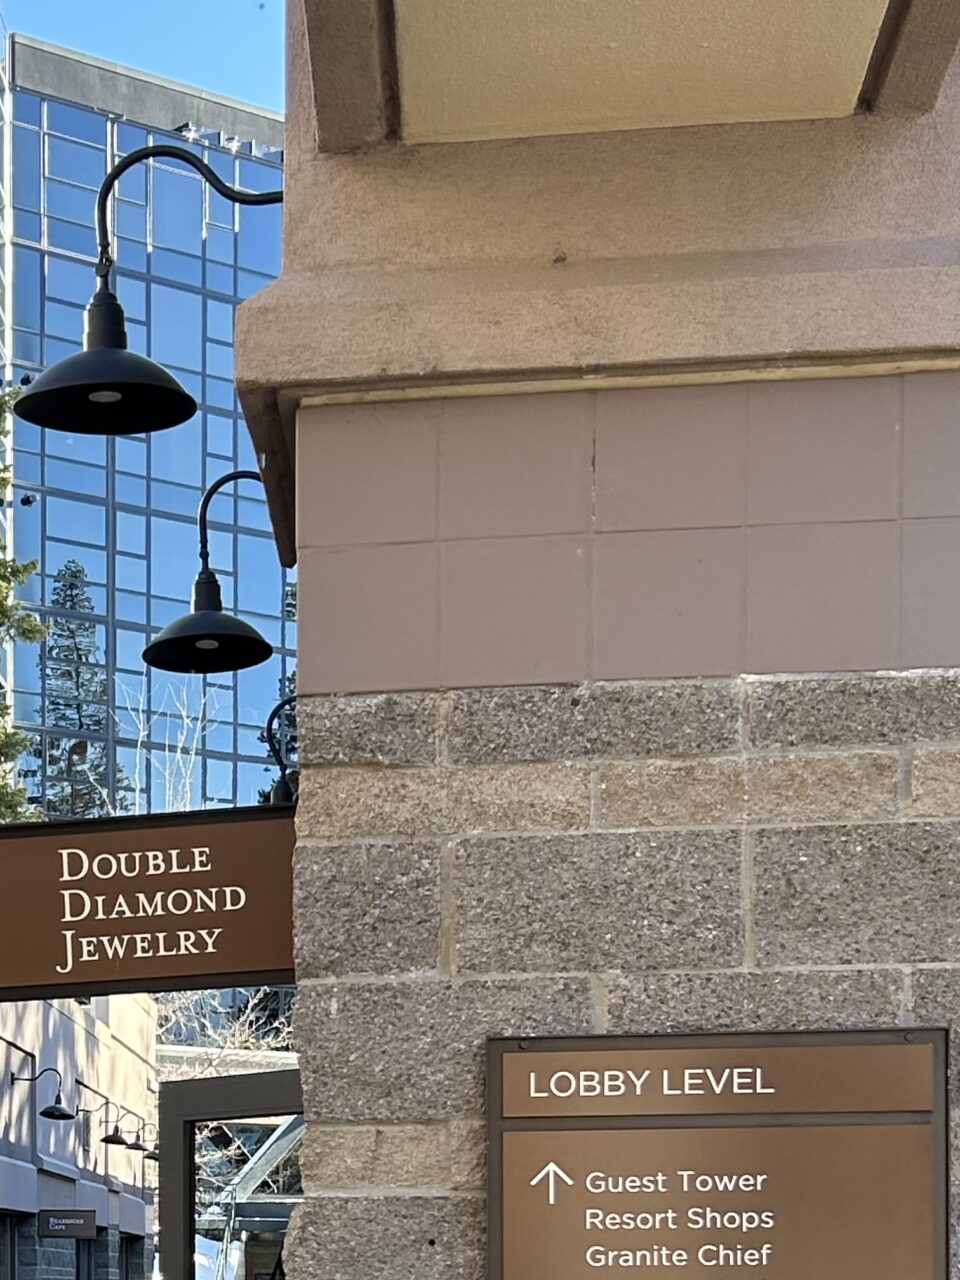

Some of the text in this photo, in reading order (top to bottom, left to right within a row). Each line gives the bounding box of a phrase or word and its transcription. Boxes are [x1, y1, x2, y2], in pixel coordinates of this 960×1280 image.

[530, 1067, 776, 1098] LOBBY LEVEL
[585, 1170, 768, 1193] Guest Tower
[585, 1206, 774, 1232] Resort Shops
[585, 1243, 772, 1267] Granite Chief
